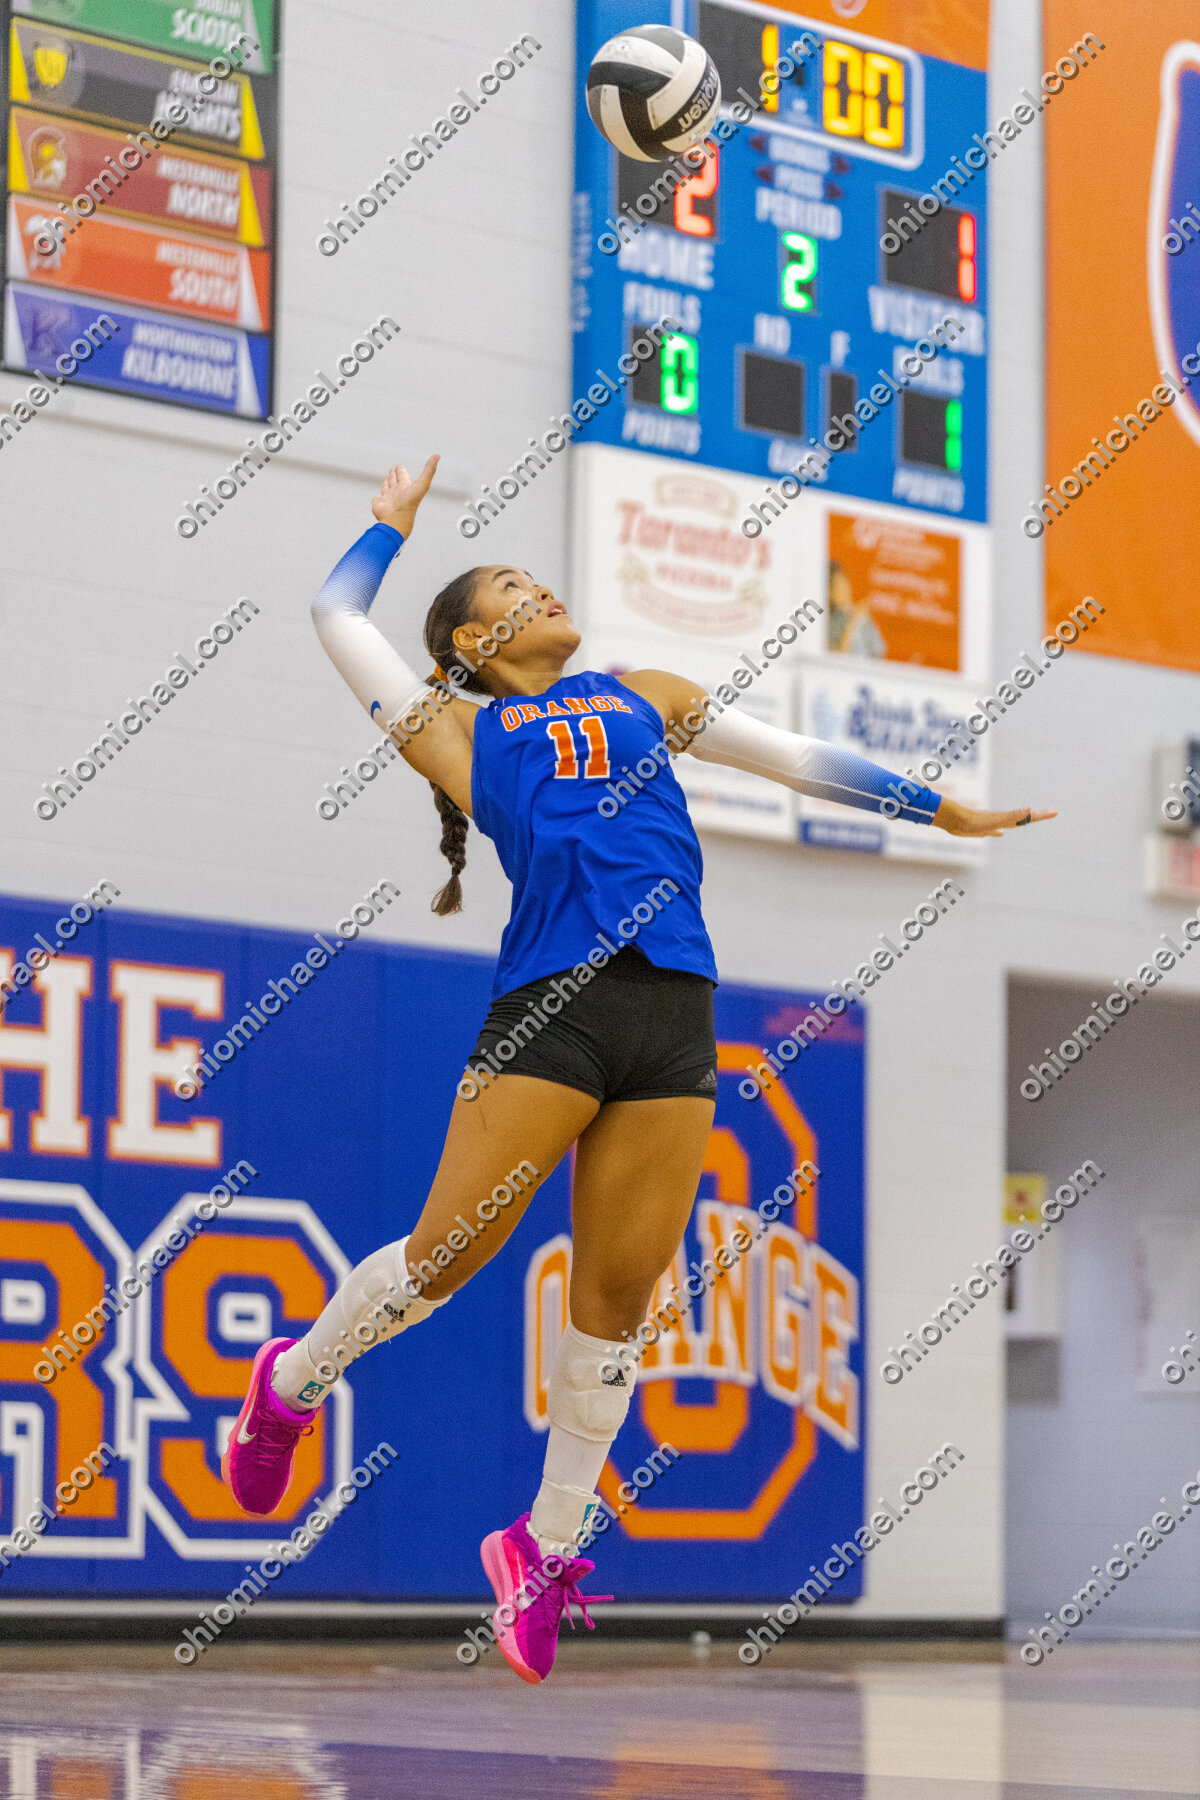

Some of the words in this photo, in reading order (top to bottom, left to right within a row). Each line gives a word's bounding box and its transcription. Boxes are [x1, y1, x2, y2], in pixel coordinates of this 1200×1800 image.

[167, 182, 239, 226] NORTH
[675, 138, 718, 237] 2
[756, 186, 842, 240] PERIOD
[169, 266, 240, 310] SOUTH
[617, 228, 714, 291] HOME
[781, 231, 818, 312] 2
[957, 213, 977, 303] 1
[122, 344, 236, 398] KILBOURNE
[661, 331, 699, 414] 0
[945, 400, 962, 472] 1
[501, 696, 633, 732] ORANGE
[546, 715, 610, 779] 11
[523, 1198, 860, 1452] OANGE
